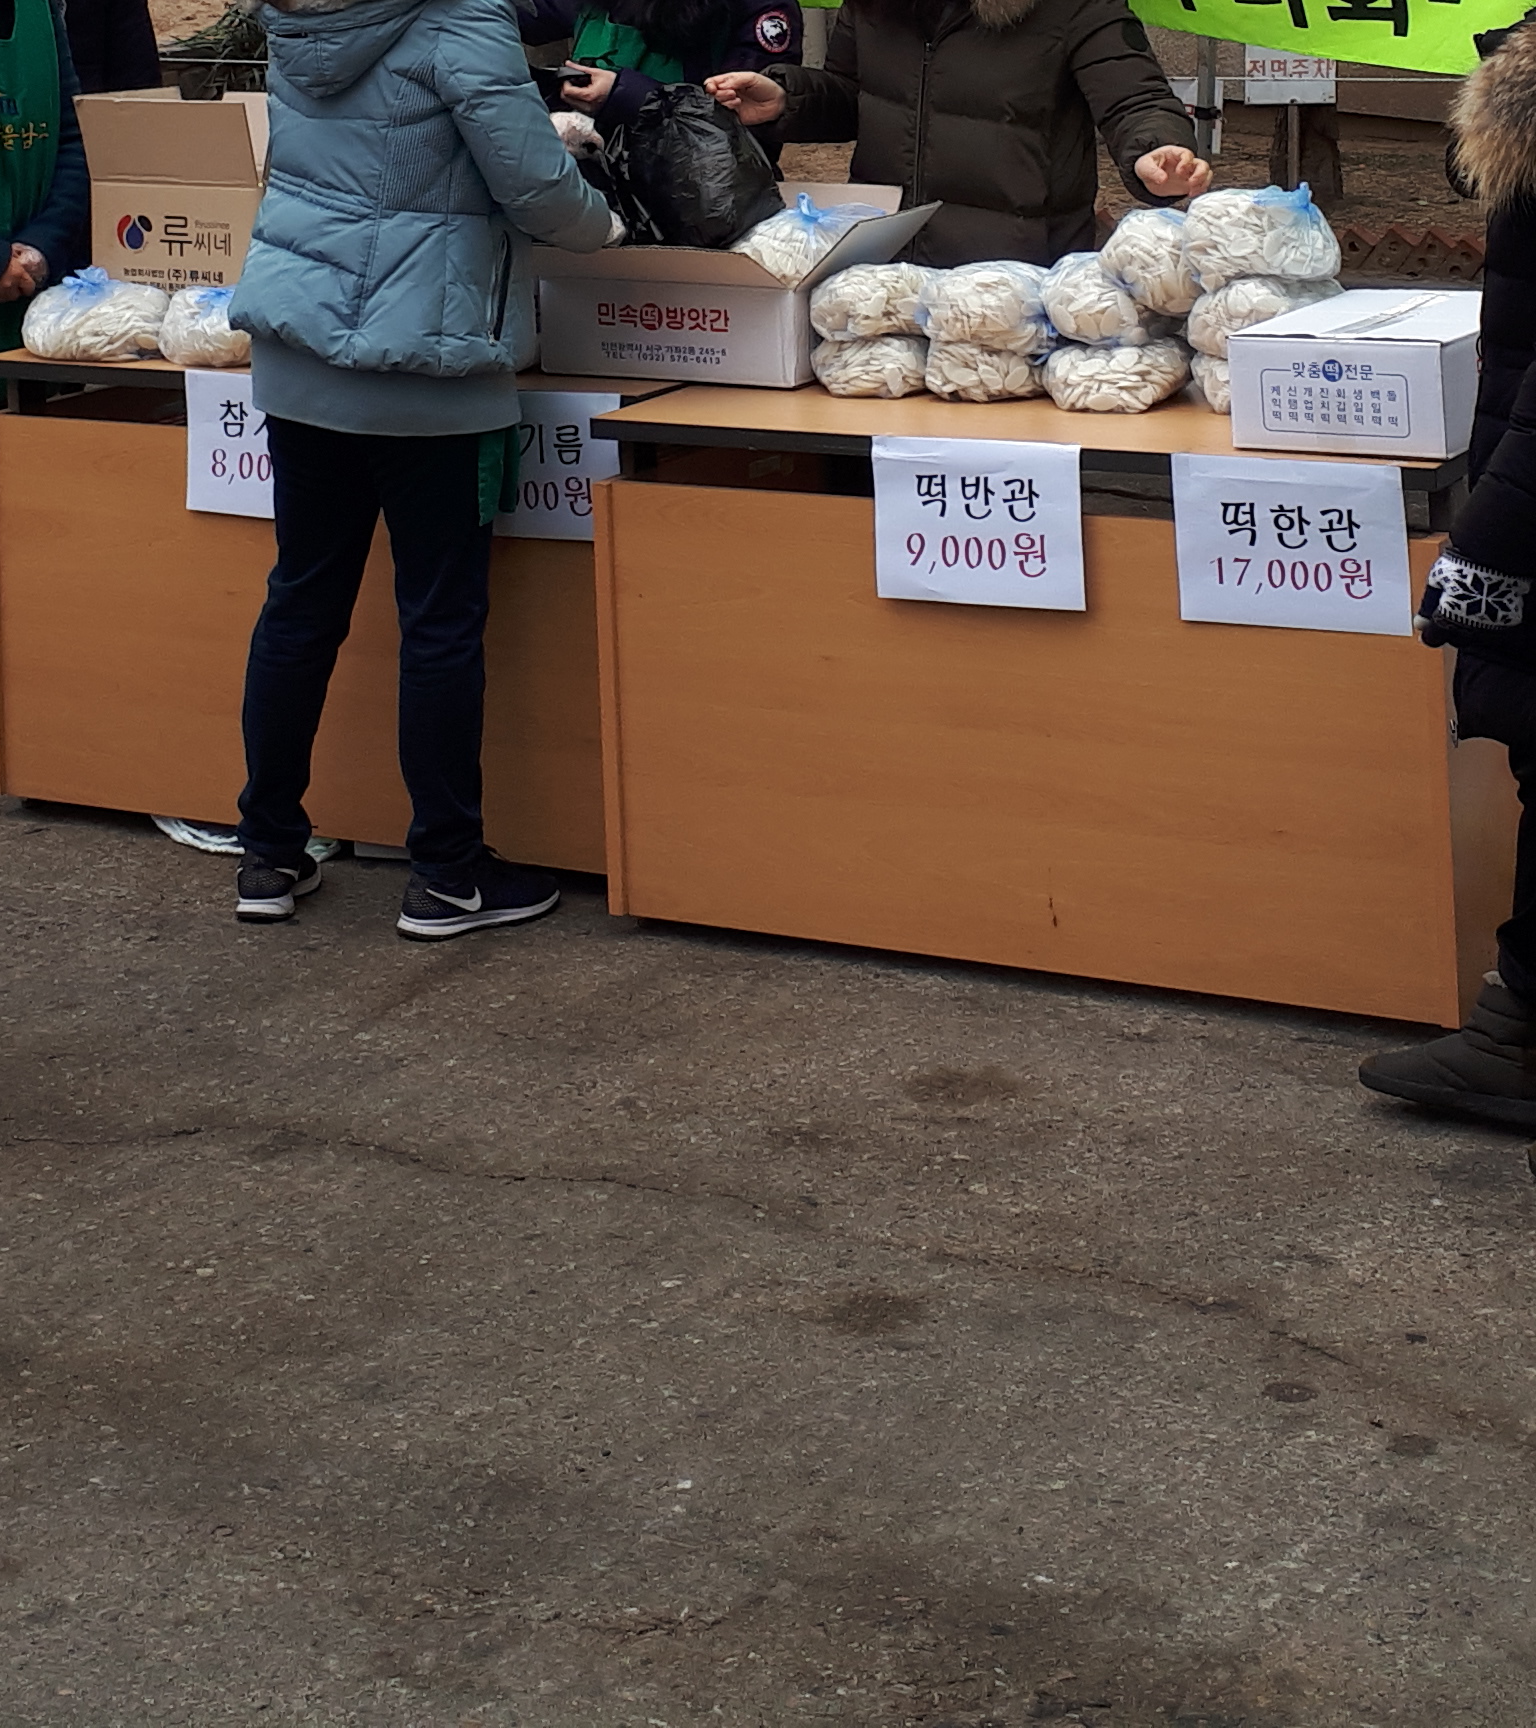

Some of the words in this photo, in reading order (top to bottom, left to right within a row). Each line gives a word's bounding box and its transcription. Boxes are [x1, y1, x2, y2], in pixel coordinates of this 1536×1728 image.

[160, 215, 232, 257] 류씨네
[219, 399, 268, 438] 참
[915, 473, 1039, 523] 떡반관
[1221, 501, 1362, 553] 떡한관
[905, 532, 1048, 578] 9,000원
[1209, 556, 1374, 601] 17,000원
